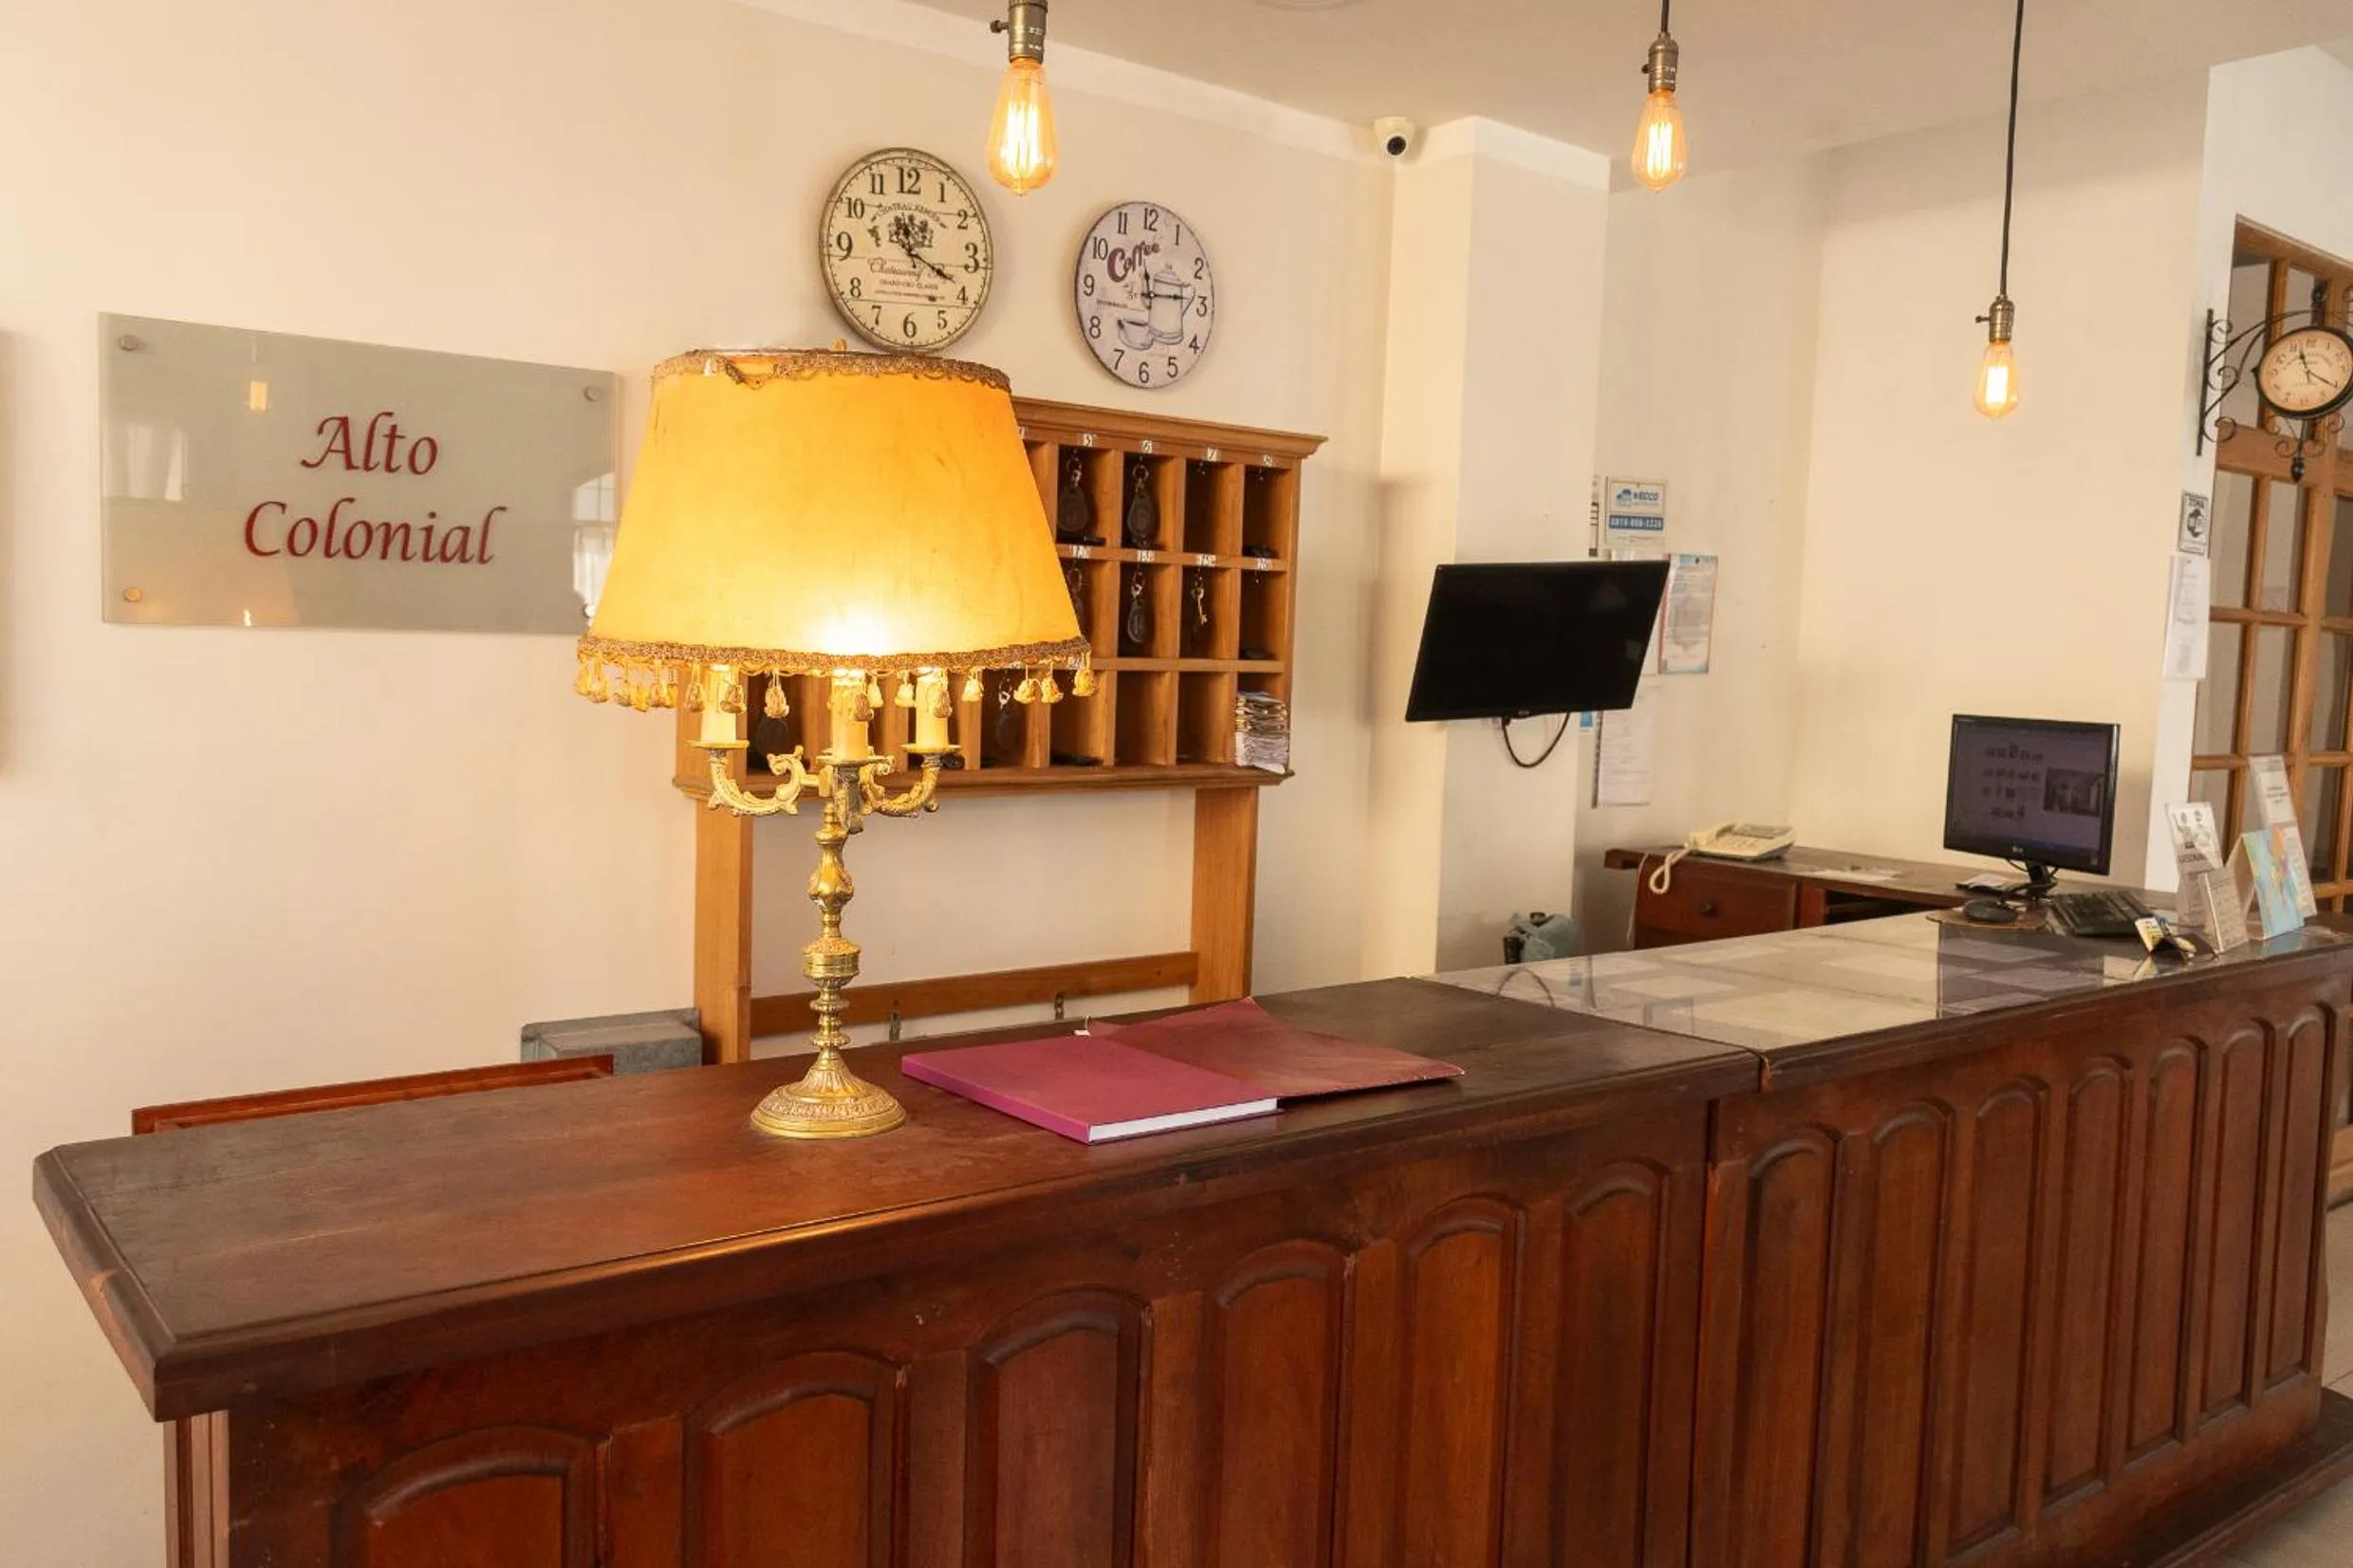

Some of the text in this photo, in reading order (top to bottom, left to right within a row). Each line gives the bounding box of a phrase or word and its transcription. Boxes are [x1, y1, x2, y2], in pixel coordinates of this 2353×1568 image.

[868, 174, 886, 195] 11
[896, 166, 921, 195] 12
[936, 182, 948, 203] 1
[844, 197, 865, 220] 10
[1142, 208, 1158, 231] 12
[956, 210, 970, 231] 2
[1117, 212, 1129, 235] 11
[836, 231, 853, 261] 9
[1174, 224, 1180, 246] 1
[964, 242, 980, 274] 3
[1092, 236, 1108, 261] 10
[1107, 241, 1161, 283] Coffee
[1194, 257, 1204, 280] 2
[849, 277, 862, 299] 8
[955, 286, 969, 305] 4
[1084, 274, 1095, 297] 9
[871, 305, 882, 325] 7
[1195, 296, 1208, 317] 3
[902, 312, 917, 338] 6
[936, 310, 948, 329] 5
[1088, 316, 1102, 339] 8
[1189, 334, 1200, 355] 4
[1113, 348, 1125, 371] 7
[1166, 357, 1178, 378] 5
[1139, 361, 1150, 384] 6
[300, 411, 439, 475] Alto
[244, 496, 508, 565] Colonial
